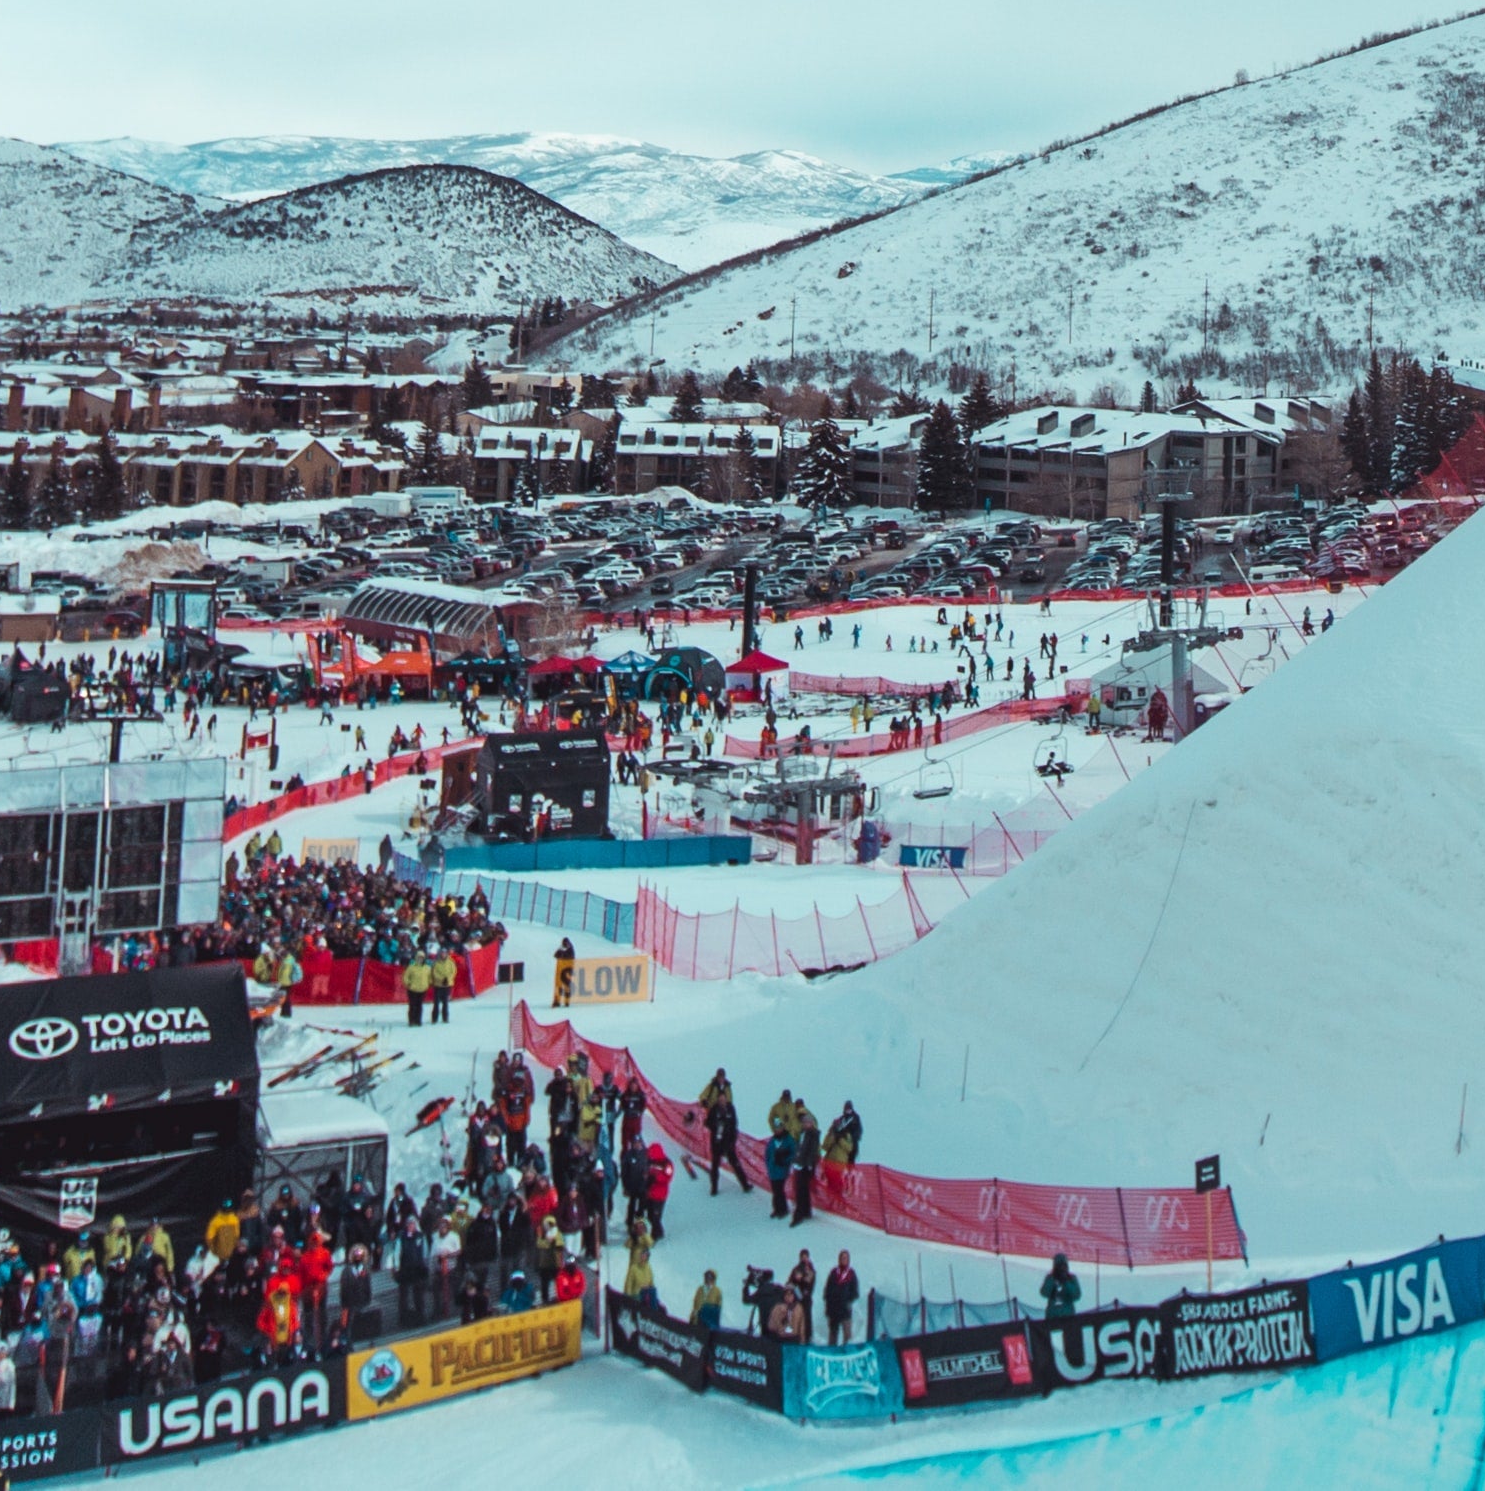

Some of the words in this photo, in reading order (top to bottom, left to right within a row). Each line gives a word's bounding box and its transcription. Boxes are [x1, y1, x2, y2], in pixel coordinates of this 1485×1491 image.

[307, 844, 356, 863] SLOW
[915, 848, 951, 867] VISA
[81, 1007, 209, 1037] TOYOTA
[90, 1035, 128, 1053] Let's
[133, 1033, 156, 1048] Go
[159, 1030, 211, 1045] Places
[1342, 1258, 1456, 1343] VISA
[118, 1369, 330, 1457] USANA
